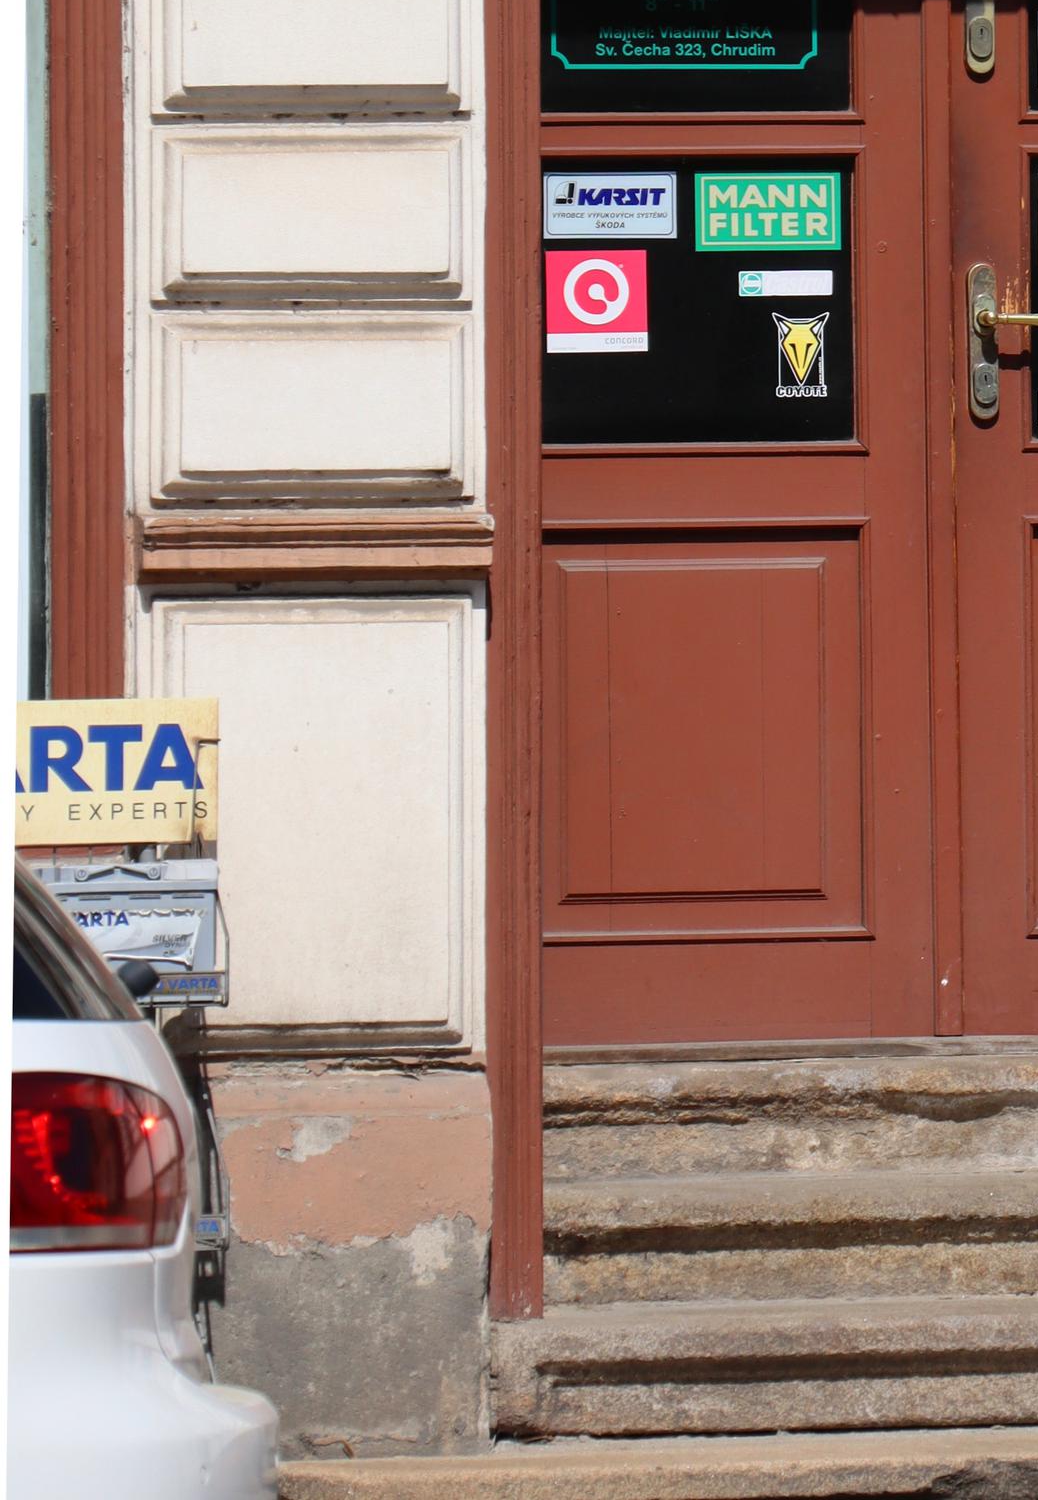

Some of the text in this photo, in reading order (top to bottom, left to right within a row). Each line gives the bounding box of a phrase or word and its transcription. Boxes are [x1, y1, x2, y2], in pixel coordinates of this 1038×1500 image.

[599, 26, 654, 42] Majitel:
[725, 25, 773, 39] LIŠKA
[595, 40, 776, 58] Sv. Čecha 323, Chrudim
[577, 187, 666, 206] KARSIT
[708, 183, 828, 209] MANN
[595, 220, 626, 229] ŠKODA
[709, 213, 828, 237] FILTER
[776, 385, 828, 397] COYOTE
[15, 723, 204, 793] RTA
[69, 801, 208, 821] EXPERTS
[168, 977, 218, 989] VARTA
